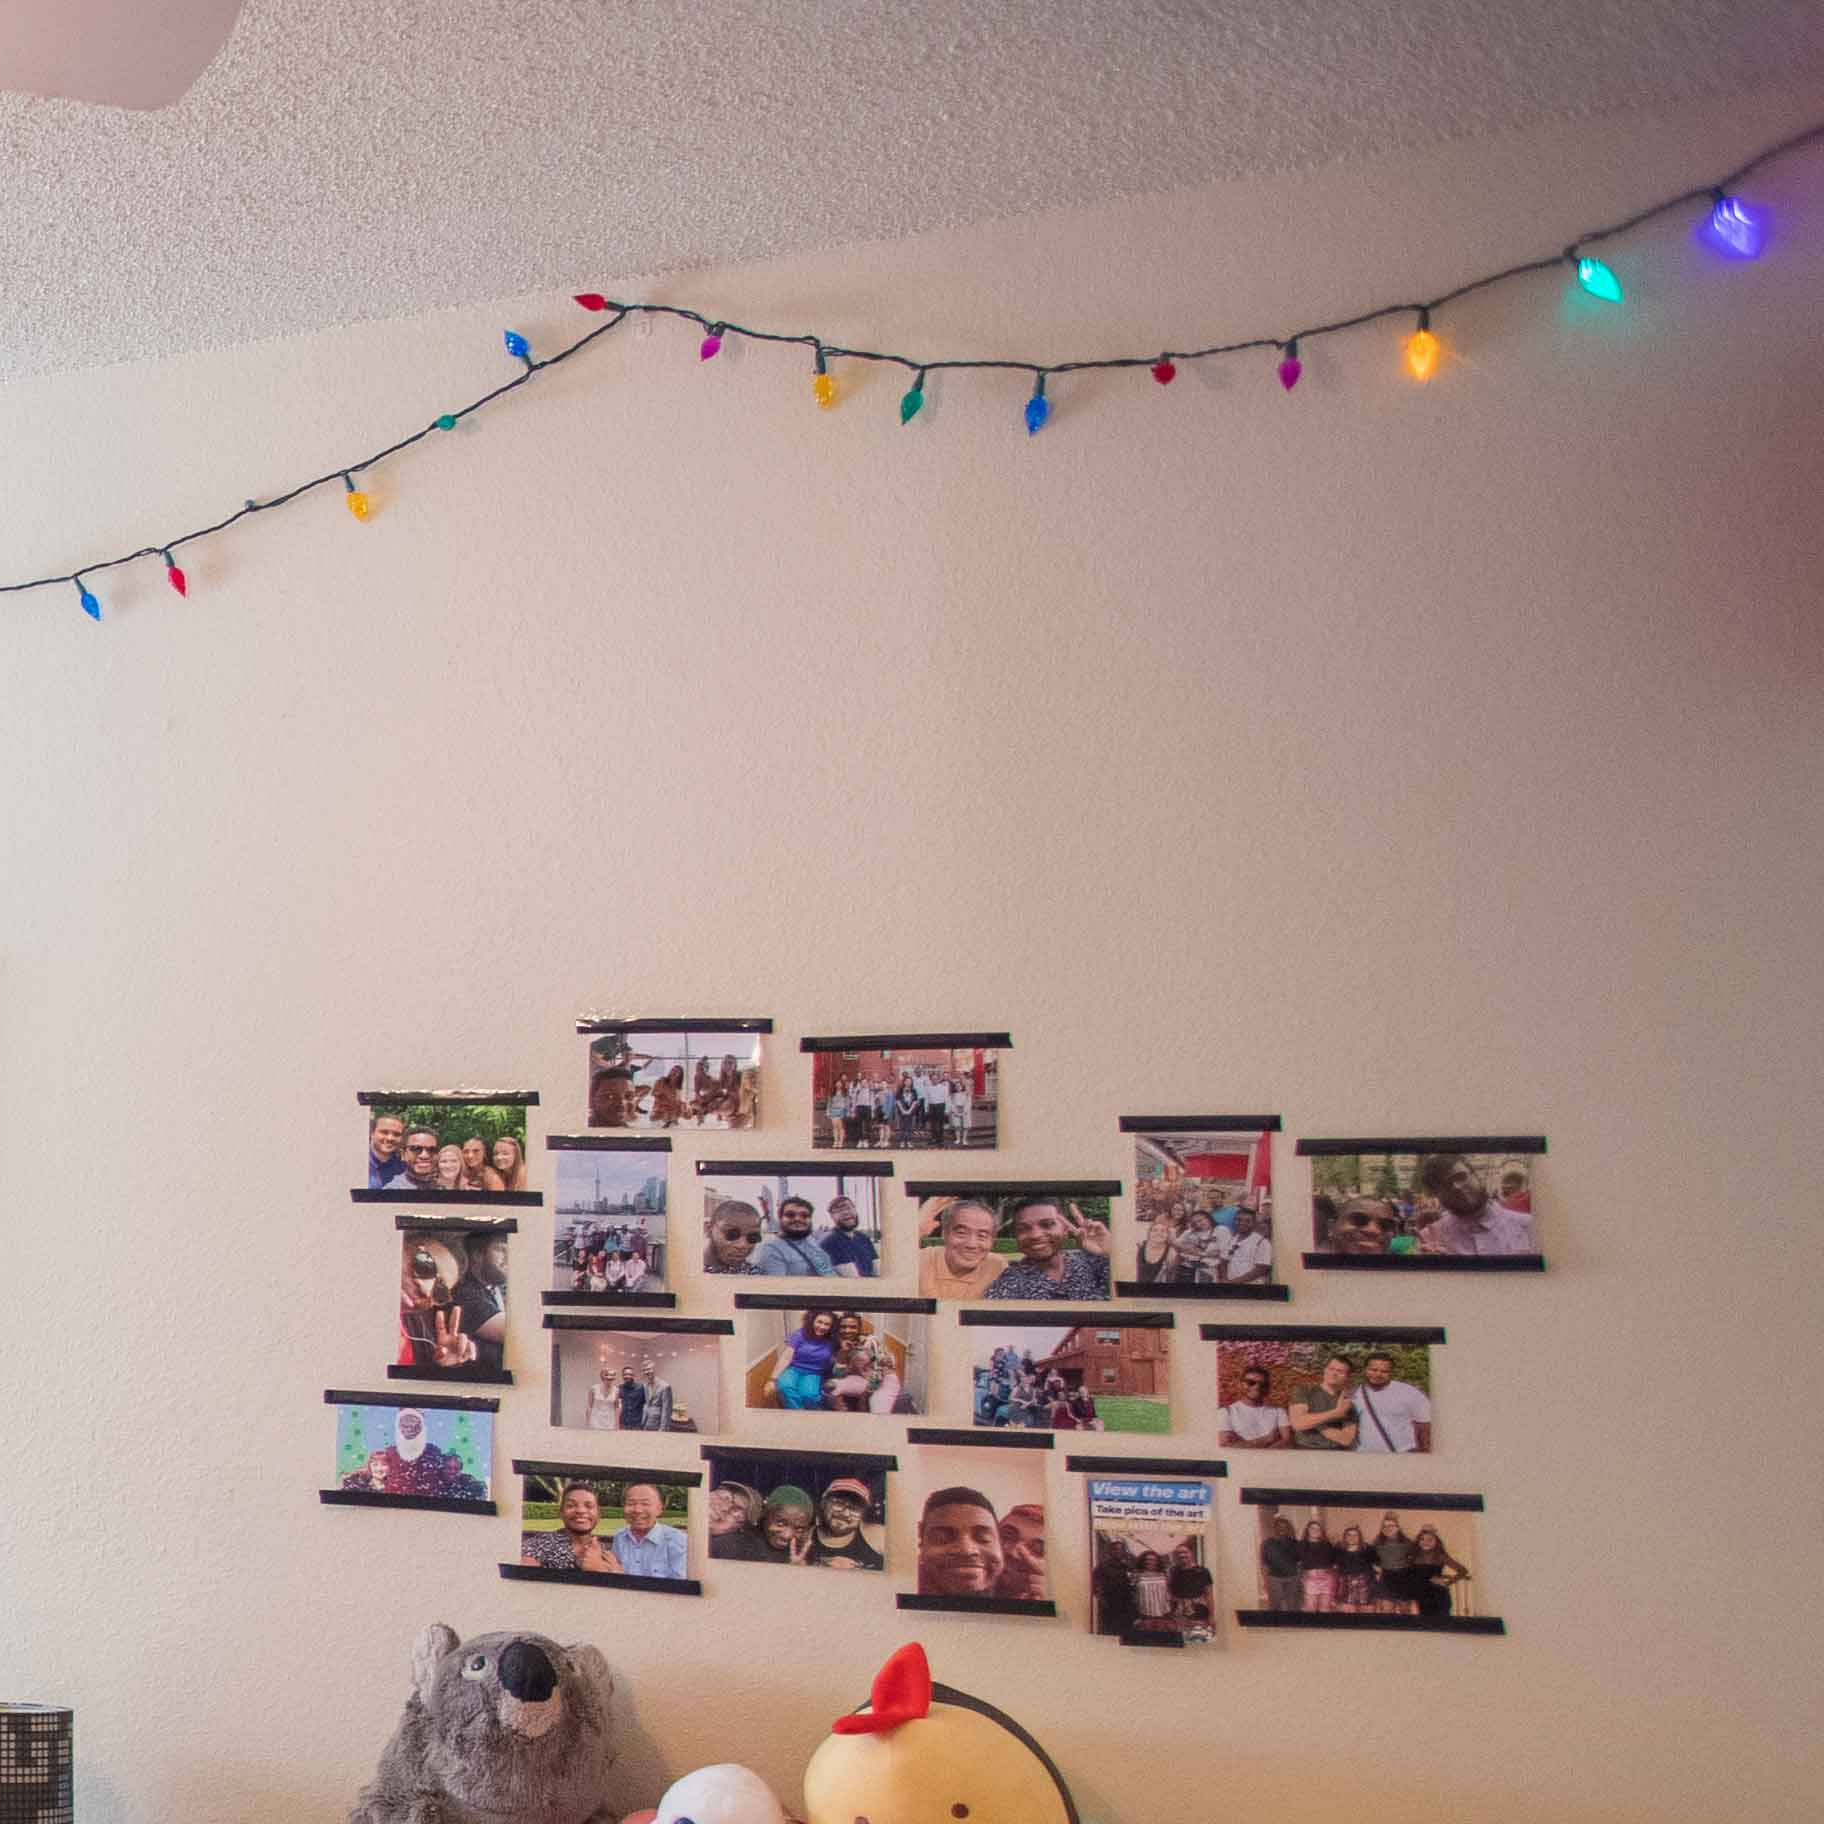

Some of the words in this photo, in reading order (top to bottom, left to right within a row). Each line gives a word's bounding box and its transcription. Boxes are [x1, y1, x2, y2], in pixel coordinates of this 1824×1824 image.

[1093, 1482, 1138, 1496] View
[1142, 1485, 1174, 1498] the
[1177, 1486, 1208, 1500] art
[1096, 1504, 1122, 1515] Take
[1124, 1505, 1149, 1517] pics
[1151, 1507, 1163, 1517] of
[1165, 1508, 1185, 1518] the
[1187, 1509, 1204, 1519] art
